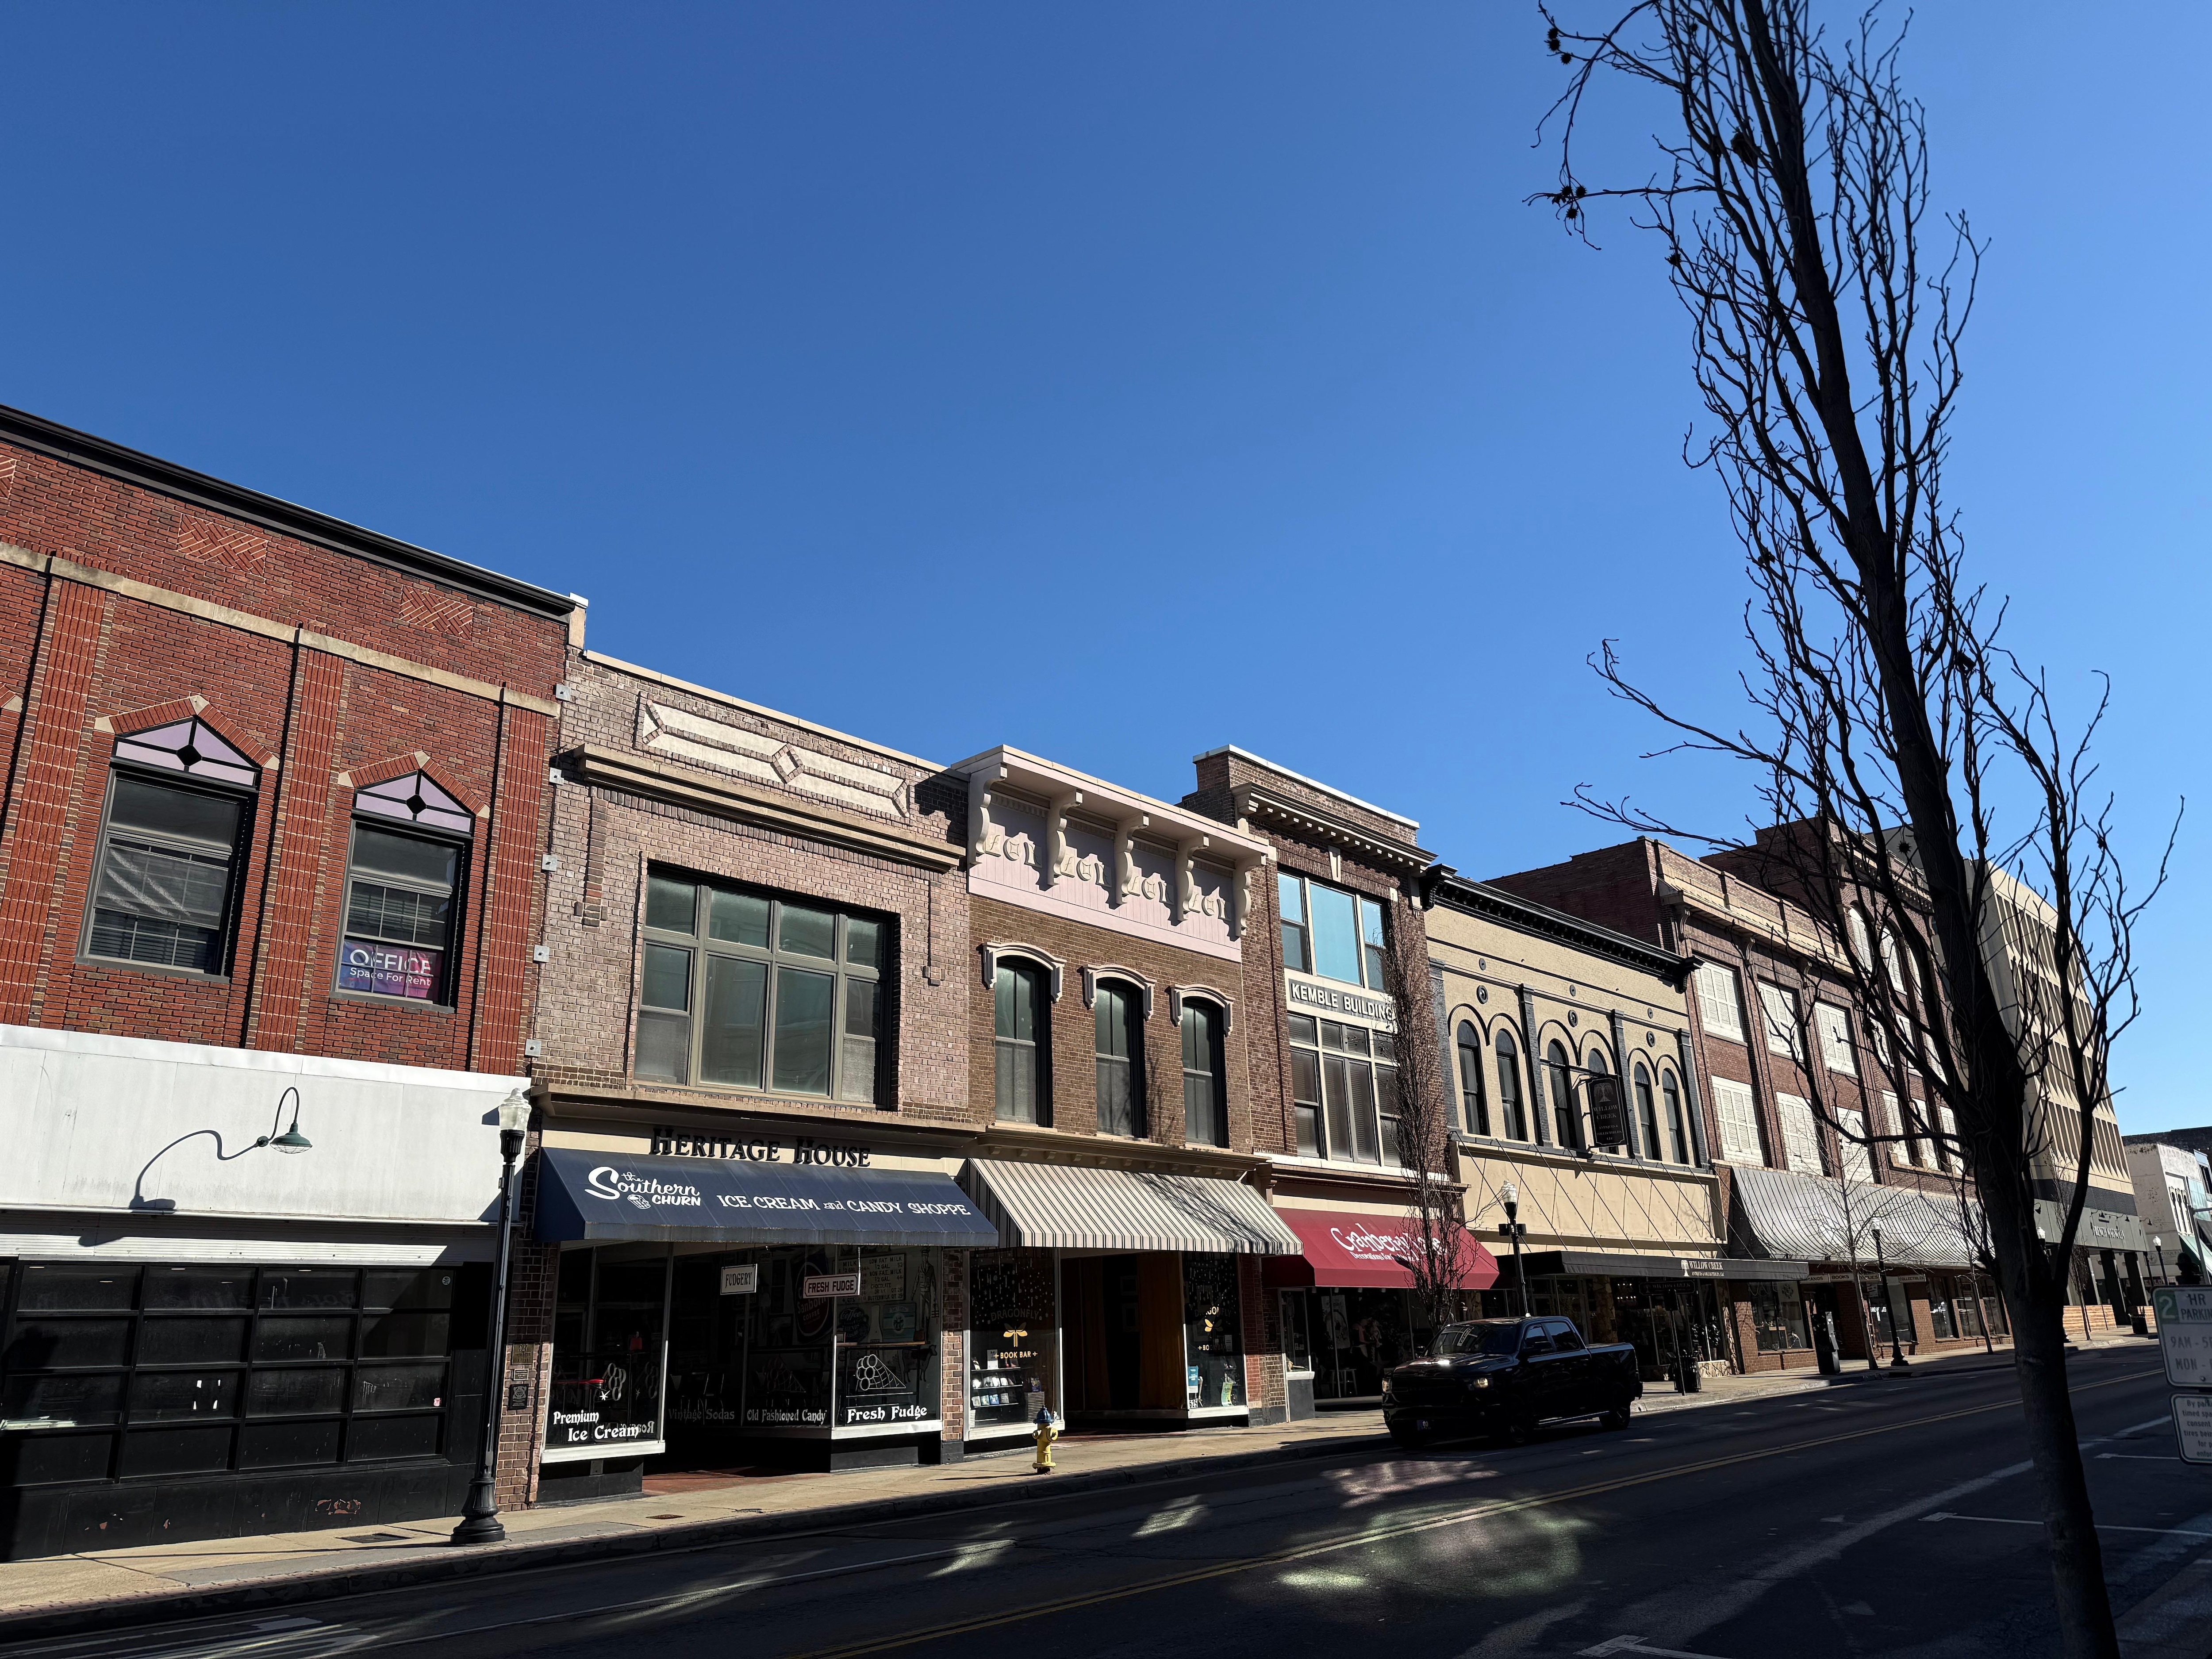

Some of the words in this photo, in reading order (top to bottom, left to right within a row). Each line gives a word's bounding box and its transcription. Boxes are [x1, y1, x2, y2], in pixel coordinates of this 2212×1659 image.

[349, 949, 431, 975] OFFICE
[349, 967, 383, 979] Space
[386, 972, 403, 983] For
[406, 975, 431, 986] Rent
[1291, 983, 1338, 1008] KEMBLE
[1343, 996, 1396, 1021] BUILDING
[650, 1128, 780, 1161] HERITAGE
[793, 1139, 871, 1167] HOUSE
[584, 1166, 700, 1200] Southern
[621, 1171, 644, 1182] the
[652, 1194, 701, 1206] CHURN
[716, 1194, 752, 1208] ICE
[753, 1196, 821, 1210] CREAM
[823, 1201, 846, 1211] and
[847, 1200, 903, 1213] CANDY
[907, 1202, 972, 1215] SHOPPE
[1689, 1261, 1708, 1269] WILLOW
[725, 1272, 752, 1288] FUDGERY
[808, 1282, 829, 1293] FRESH
[832, 1280, 854, 1292] FUDGE
[2159, 1295, 2175, 1319] 2
[2190, 1294, 2206, 1305] HR
[991, 1308, 1039, 1321] DRAGONFLY
[2170, 1336, 2192, 1348] 9AM
[2176, 1358, 2197, 1370] MON
[553, 1409, 599, 1425] Premium
[668, 1409, 702, 1423] Vintage
[706, 1408, 735, 1420] Sodas
[747, 1409, 759, 1421] Old
[761, 1409, 799, 1424] Fashioned
[802, 1409, 826, 1425] Candy
[847, 1407, 885, 1424] Fresh
[891, 1405, 927, 1421] Fudge
[568, 1428, 588, 1442] Ice
[594, 1425, 639, 1439] Cream
